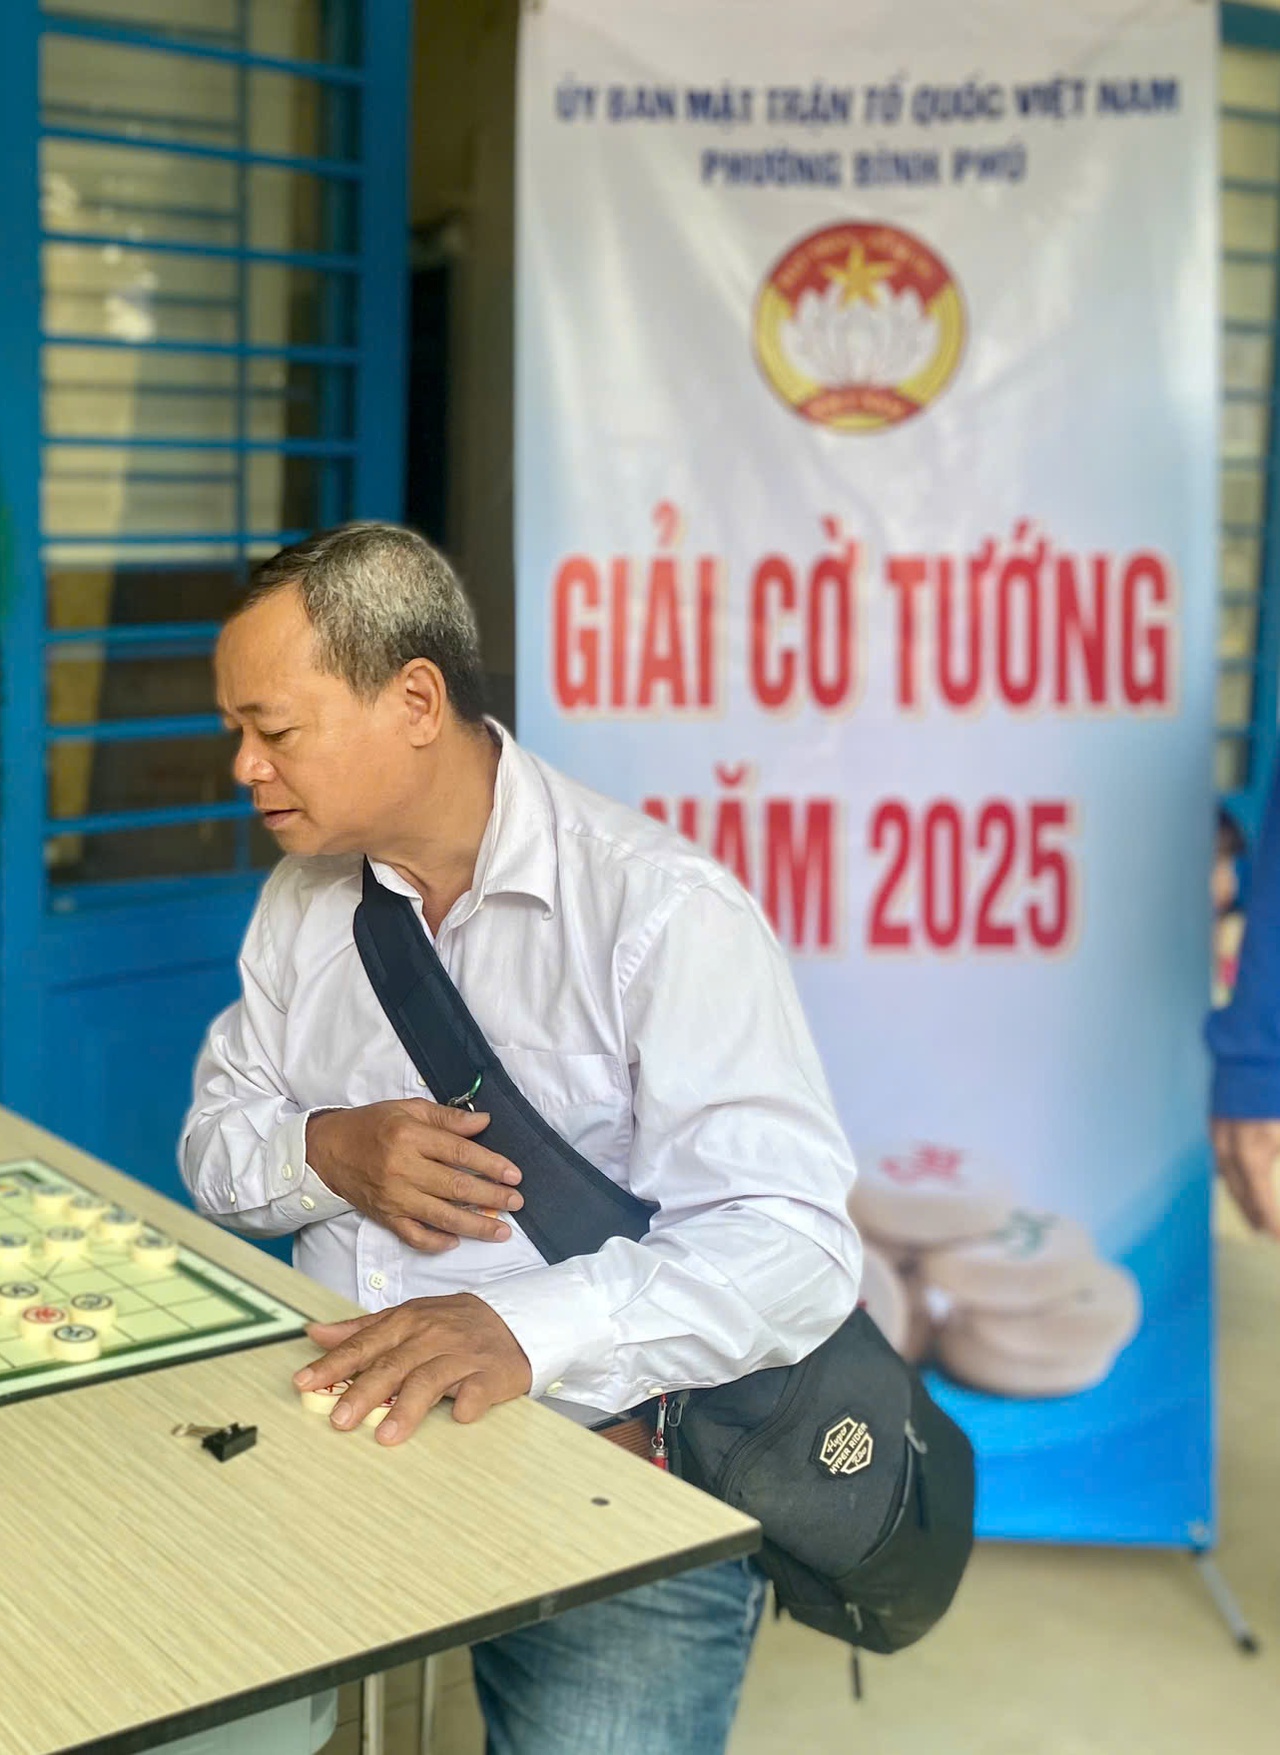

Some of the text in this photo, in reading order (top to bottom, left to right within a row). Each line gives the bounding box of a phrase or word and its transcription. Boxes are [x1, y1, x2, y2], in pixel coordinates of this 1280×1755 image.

[607, 84, 676, 121] BAN
[1097, 78, 1179, 116] NAM
[551, 500, 1173, 711] GIẢI CỜ TƯỚNG
[864, 798, 1074, 949] 2025
[829, 1422, 868, 1474] HYPER RIDER
